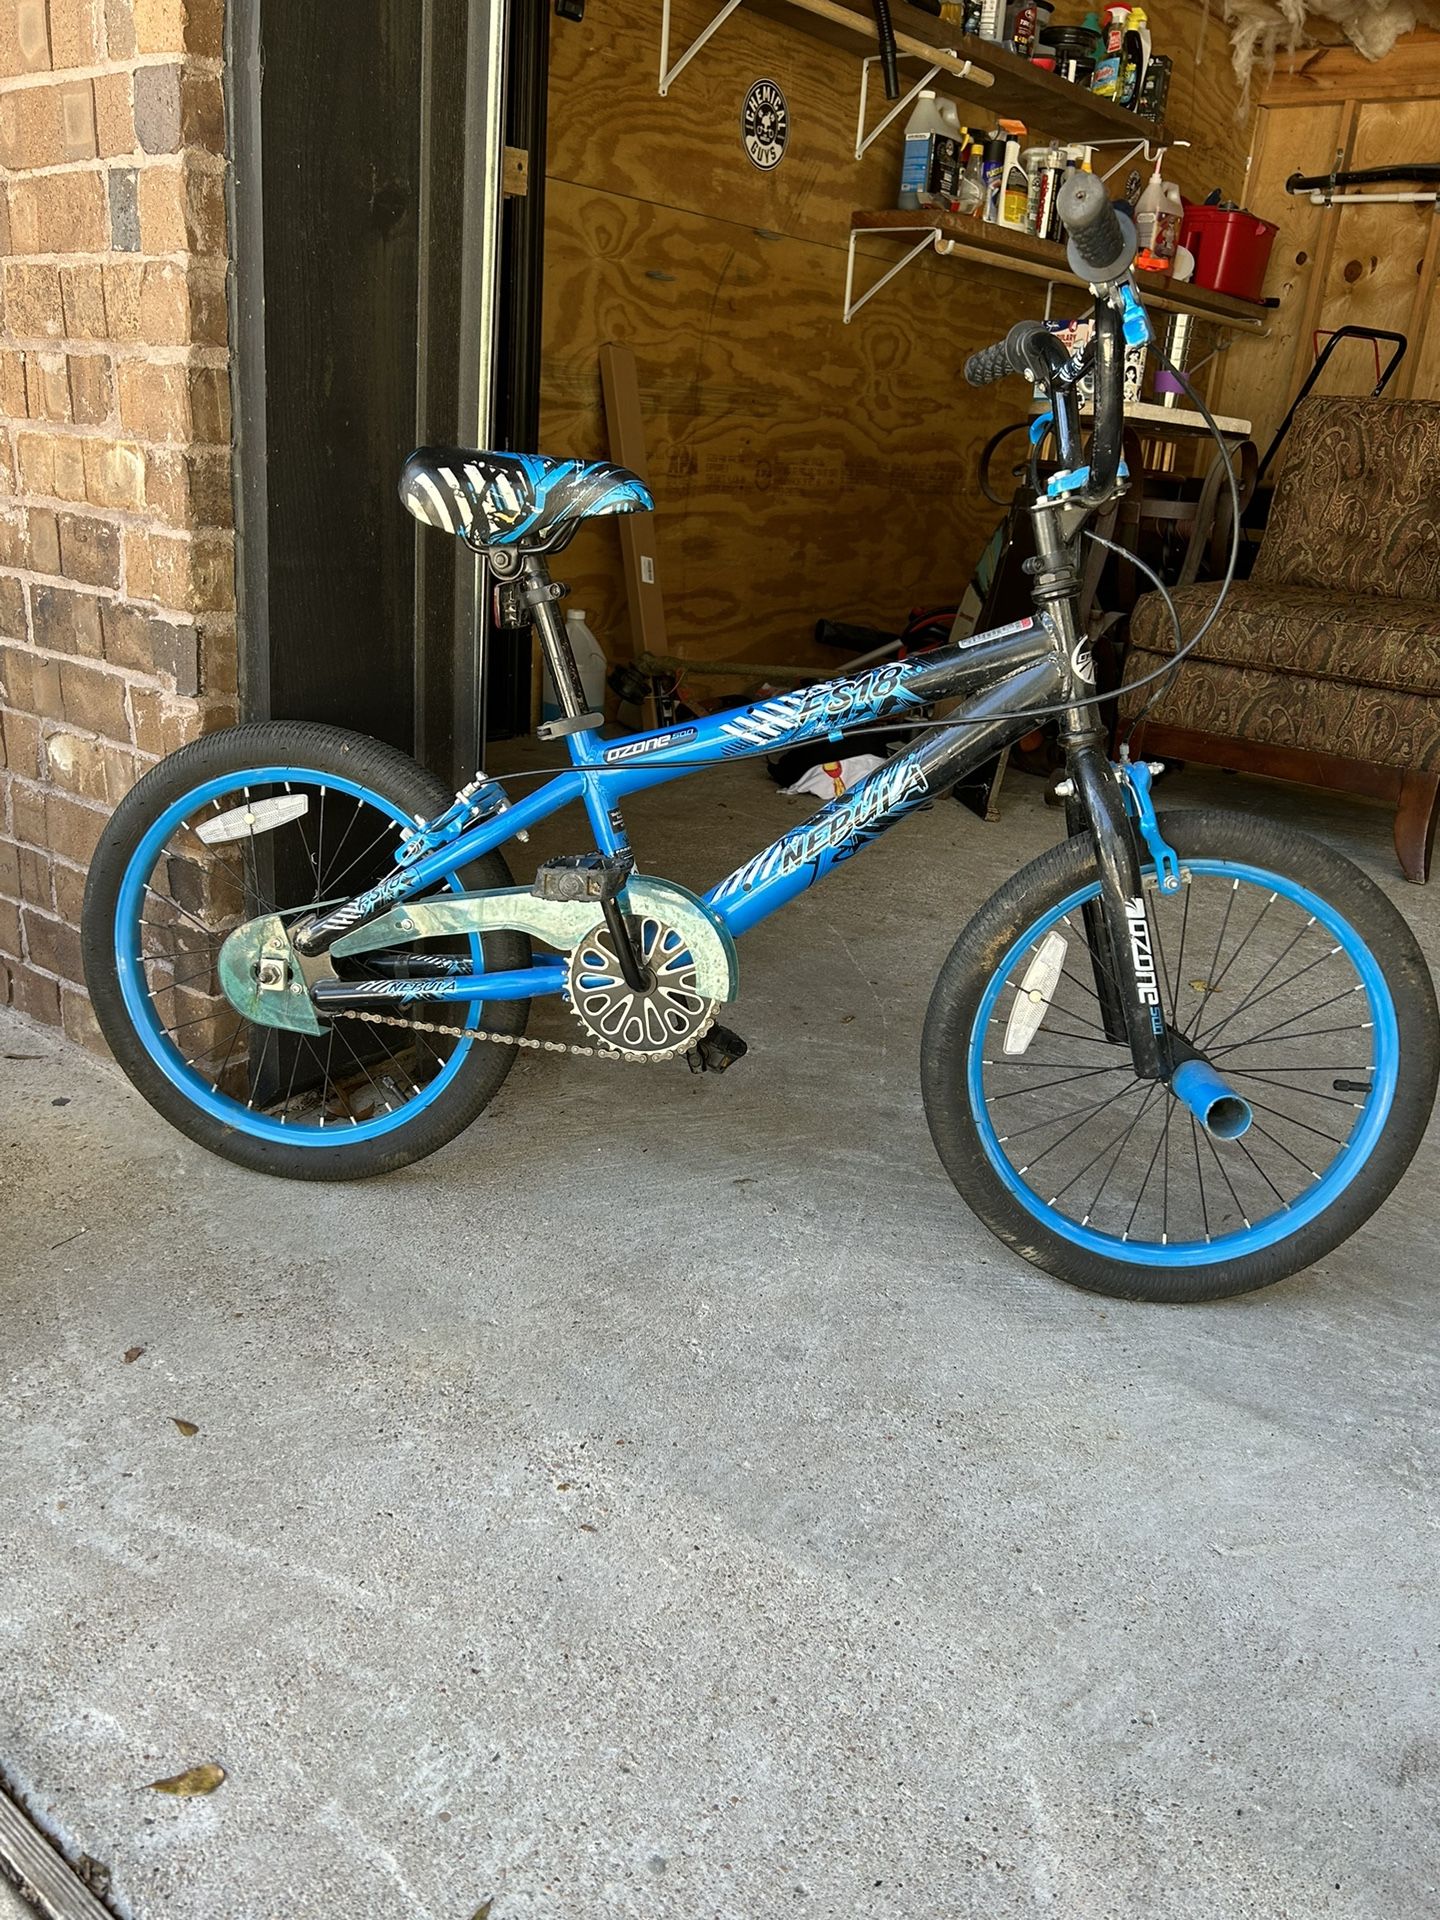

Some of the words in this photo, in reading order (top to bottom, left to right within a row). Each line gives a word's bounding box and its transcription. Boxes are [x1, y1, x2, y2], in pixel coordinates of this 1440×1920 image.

[746, 86, 786, 131] CHEMICAL
[750, 141, 776, 163] GUYS
[780, 764, 929, 875] NEBULA
[388, 980, 457, 994] NEBULA
